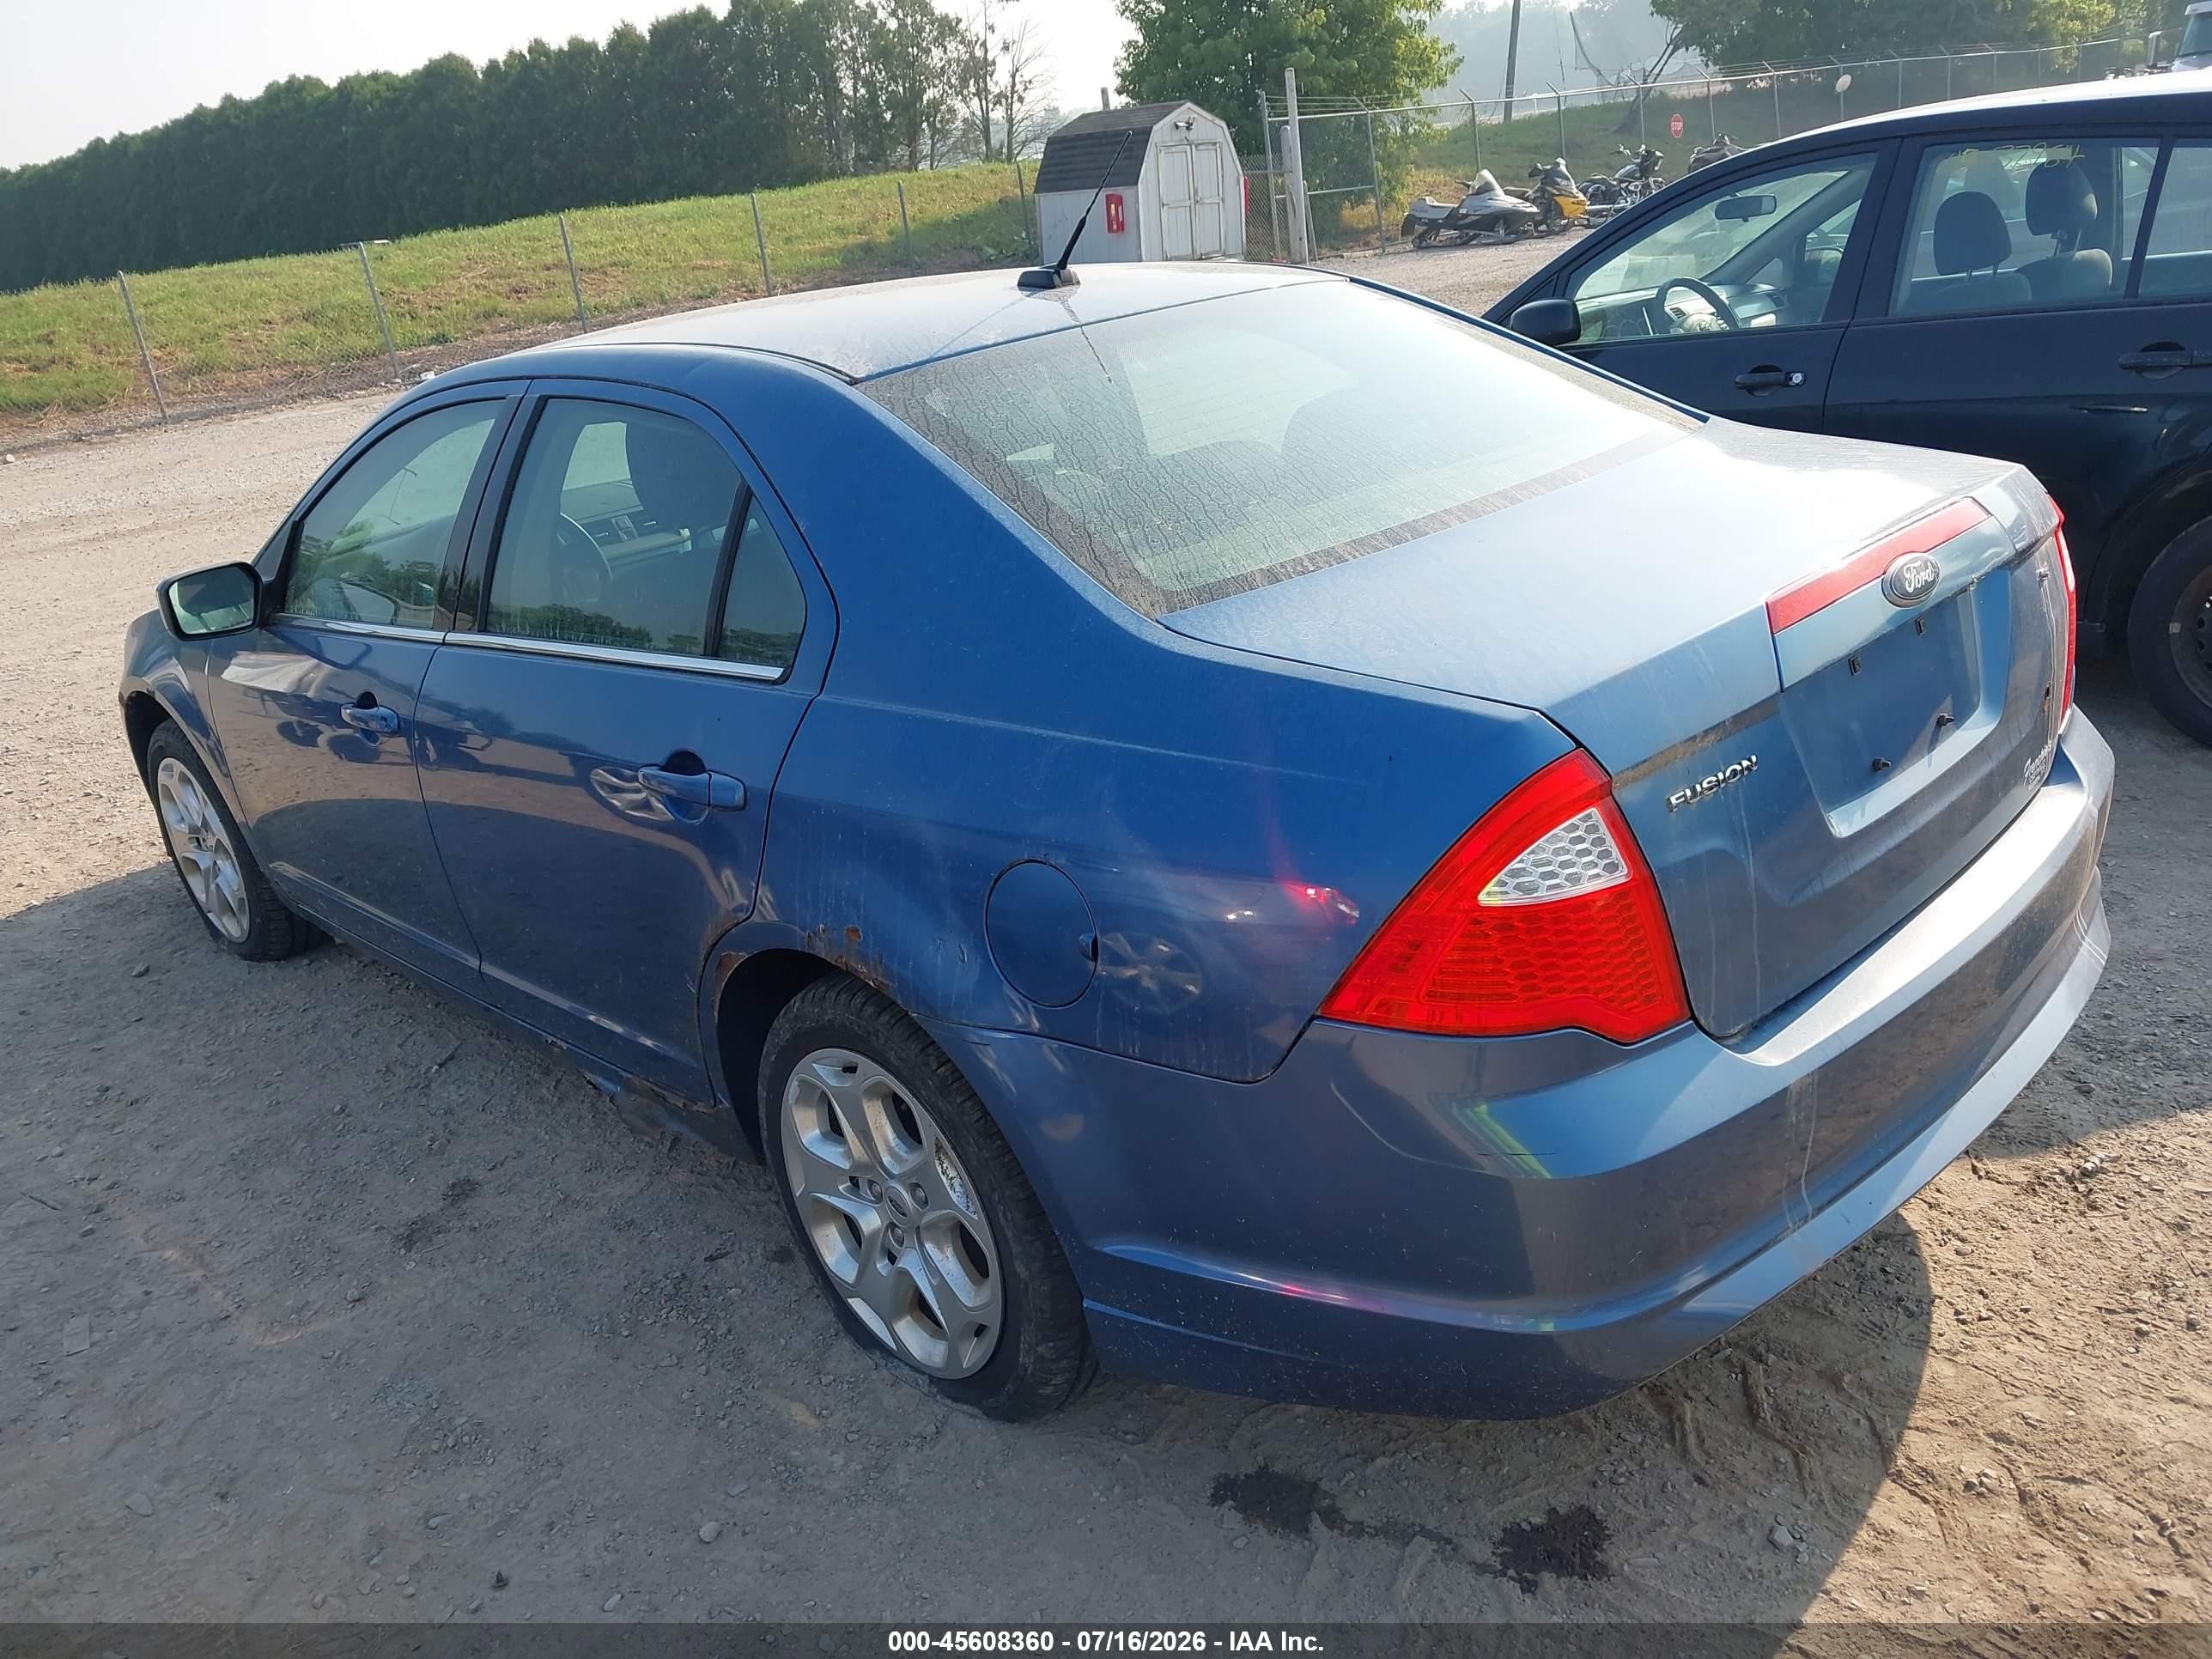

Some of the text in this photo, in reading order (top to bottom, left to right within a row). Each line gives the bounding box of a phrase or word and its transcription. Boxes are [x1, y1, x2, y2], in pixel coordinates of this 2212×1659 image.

[1671, 121, 1683, 131] STOP
[1904, 560, 1935, 593] Ford
[1668, 754, 1758, 811] FUSION
